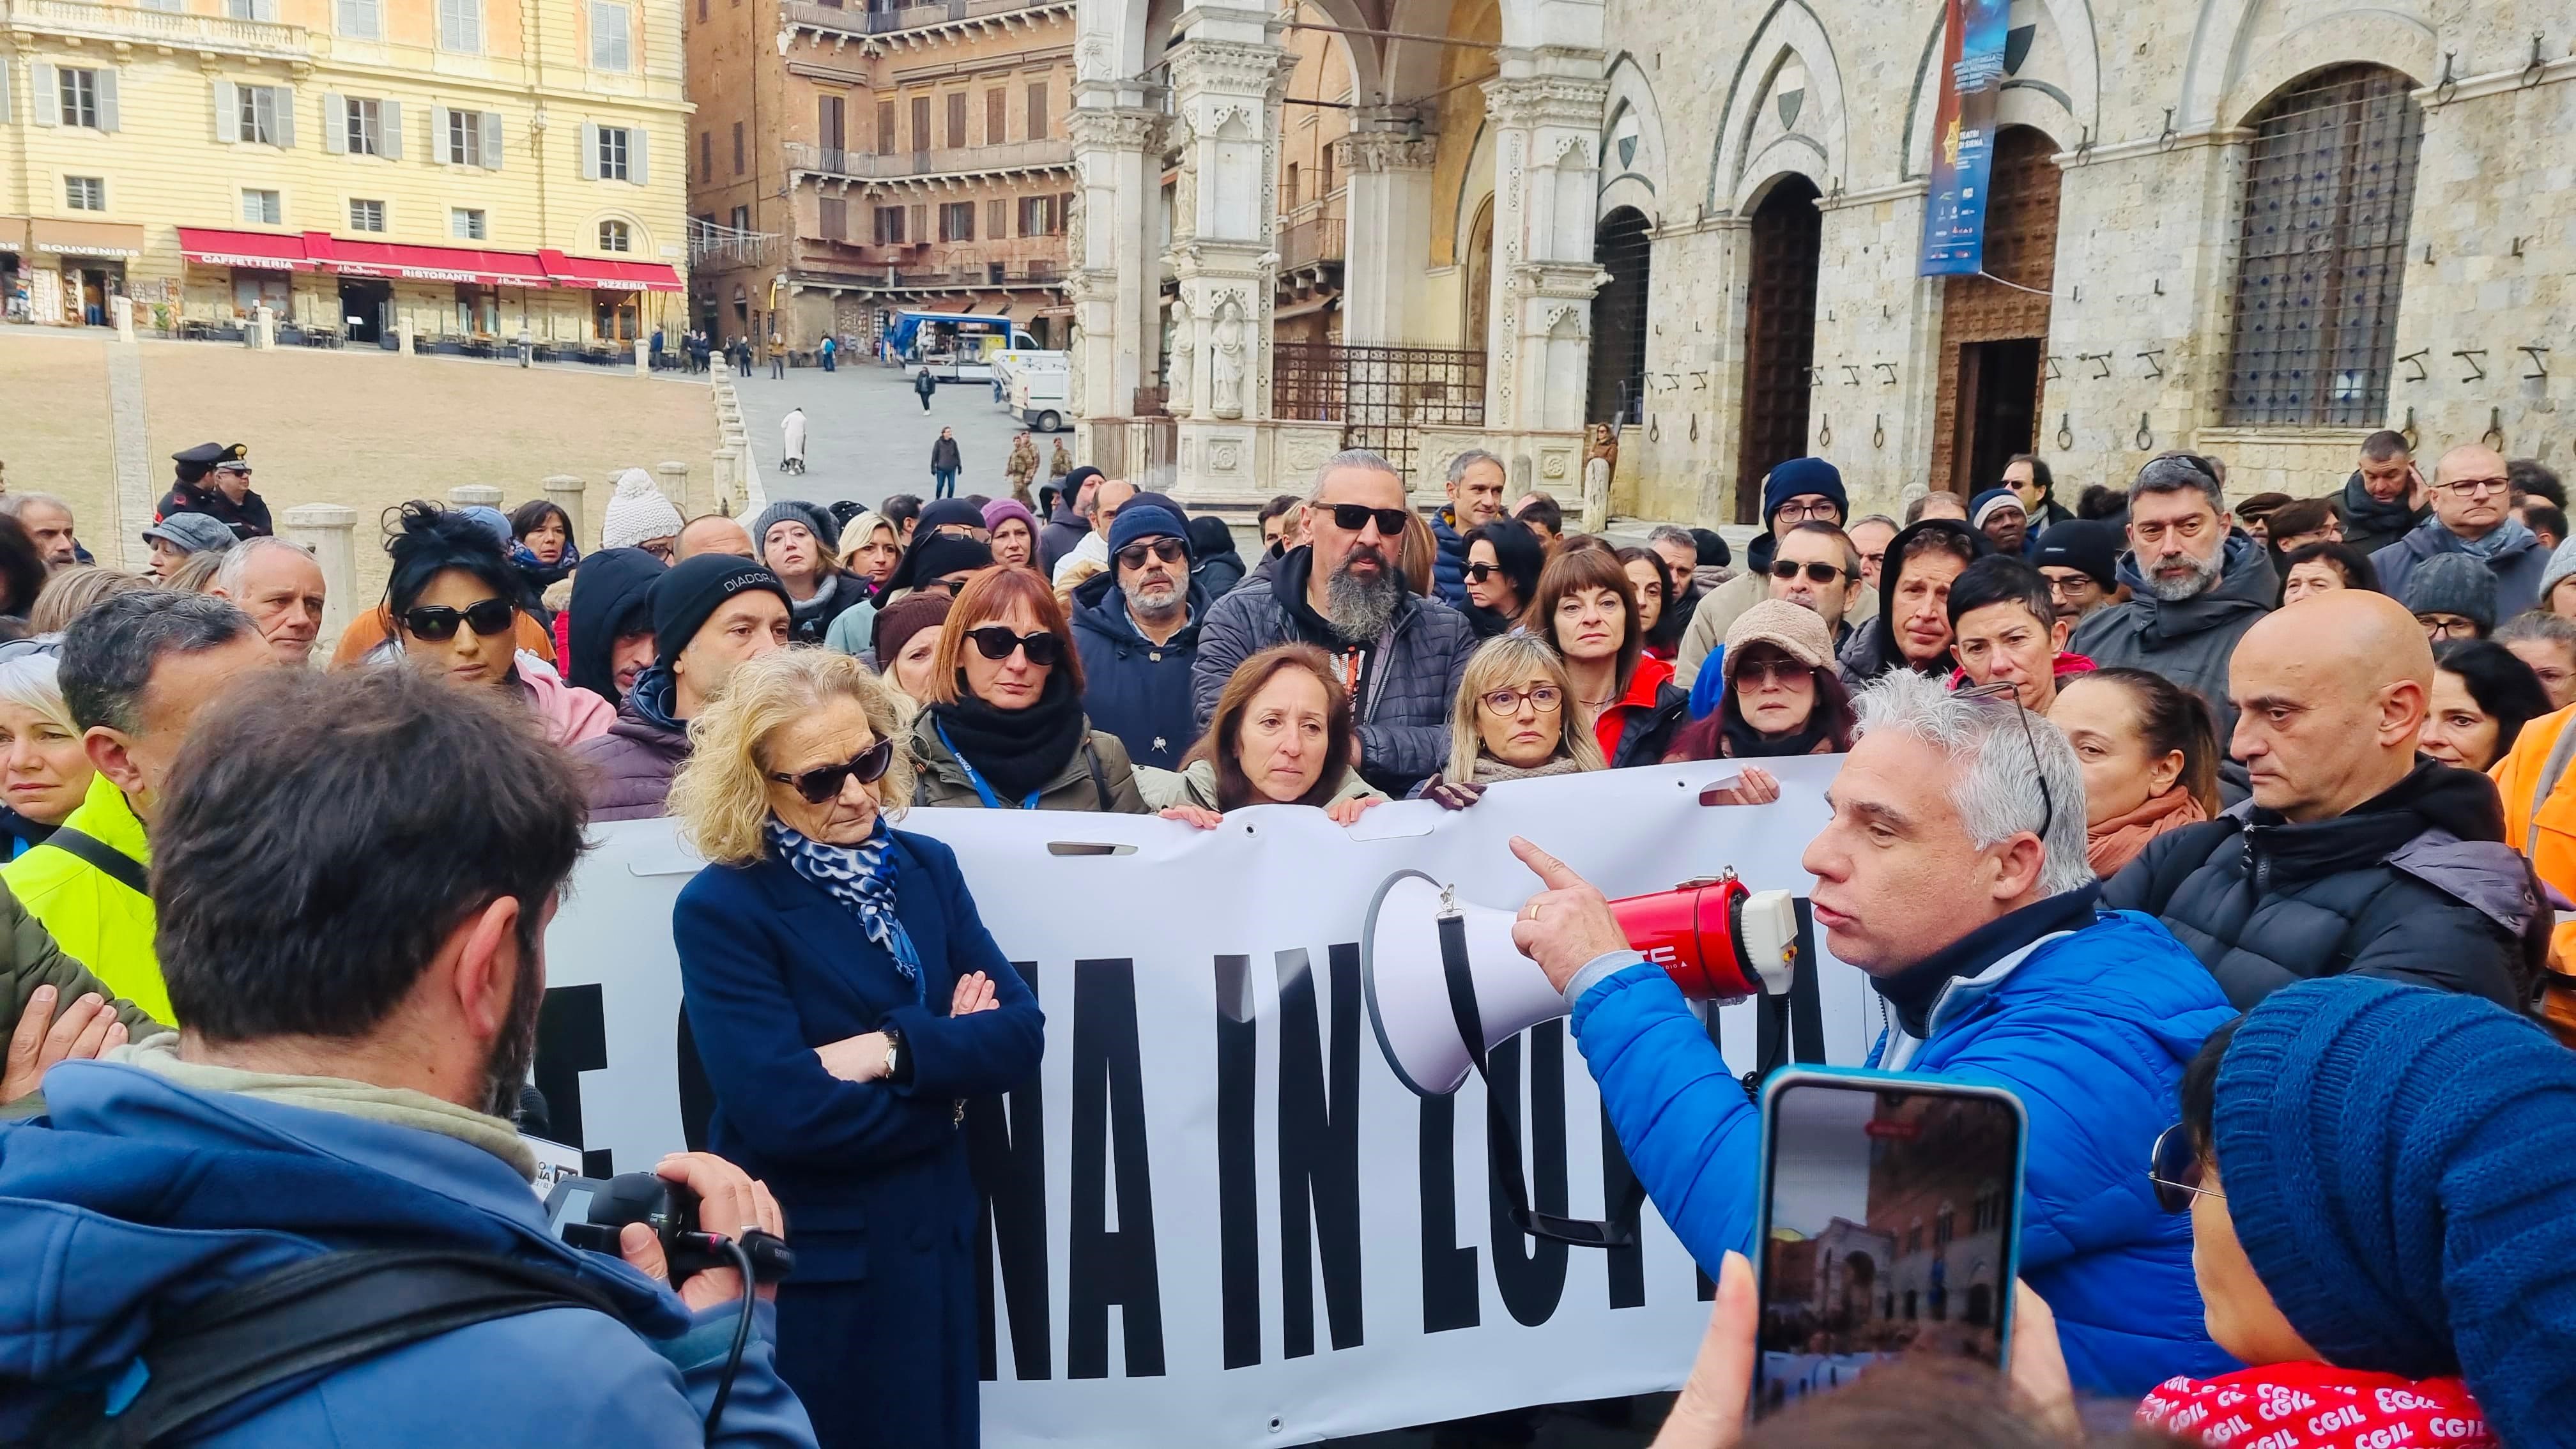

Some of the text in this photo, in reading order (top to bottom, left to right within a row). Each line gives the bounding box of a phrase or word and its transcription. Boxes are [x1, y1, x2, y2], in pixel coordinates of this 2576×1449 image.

[39, 243, 139, 257] SOUVENIRS
[201, 256, 294, 270] CAFFETTERIA
[402, 268, 477, 282] RISTORANTE
[597, 280, 649, 291] PIZZERIA
[1214, 942, 1365, 1371] IN
[2169, 1401, 2209, 1434] CGIL
[2308, 1404, 2367, 1437] CGIL
[2429, 1417, 2487, 1438] CGIL
[2202, 1414, 2414, 1449] CGIL CGIL
